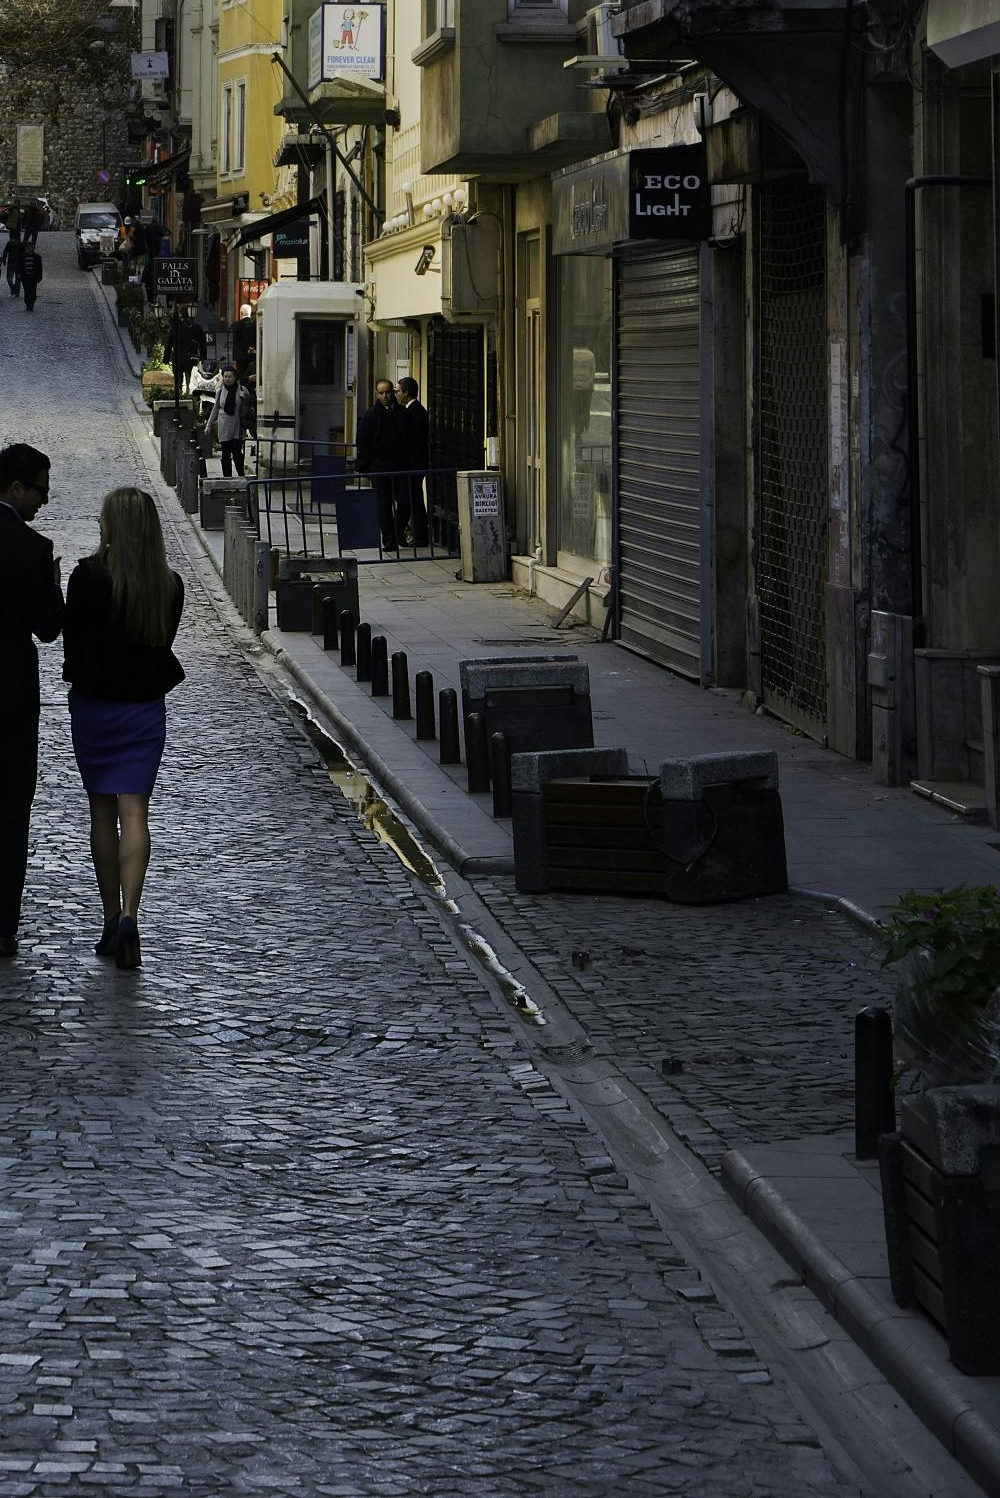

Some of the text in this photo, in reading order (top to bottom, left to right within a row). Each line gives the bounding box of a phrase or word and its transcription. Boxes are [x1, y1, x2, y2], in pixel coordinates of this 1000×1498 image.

[327, 55, 376, 64] FOREVER CLEAN
[644, 175, 700, 190] ECO
[635, 193, 691, 216] LIGHT
[162, 262, 189, 270] FALLS
[157, 277, 193, 285] GALATA
